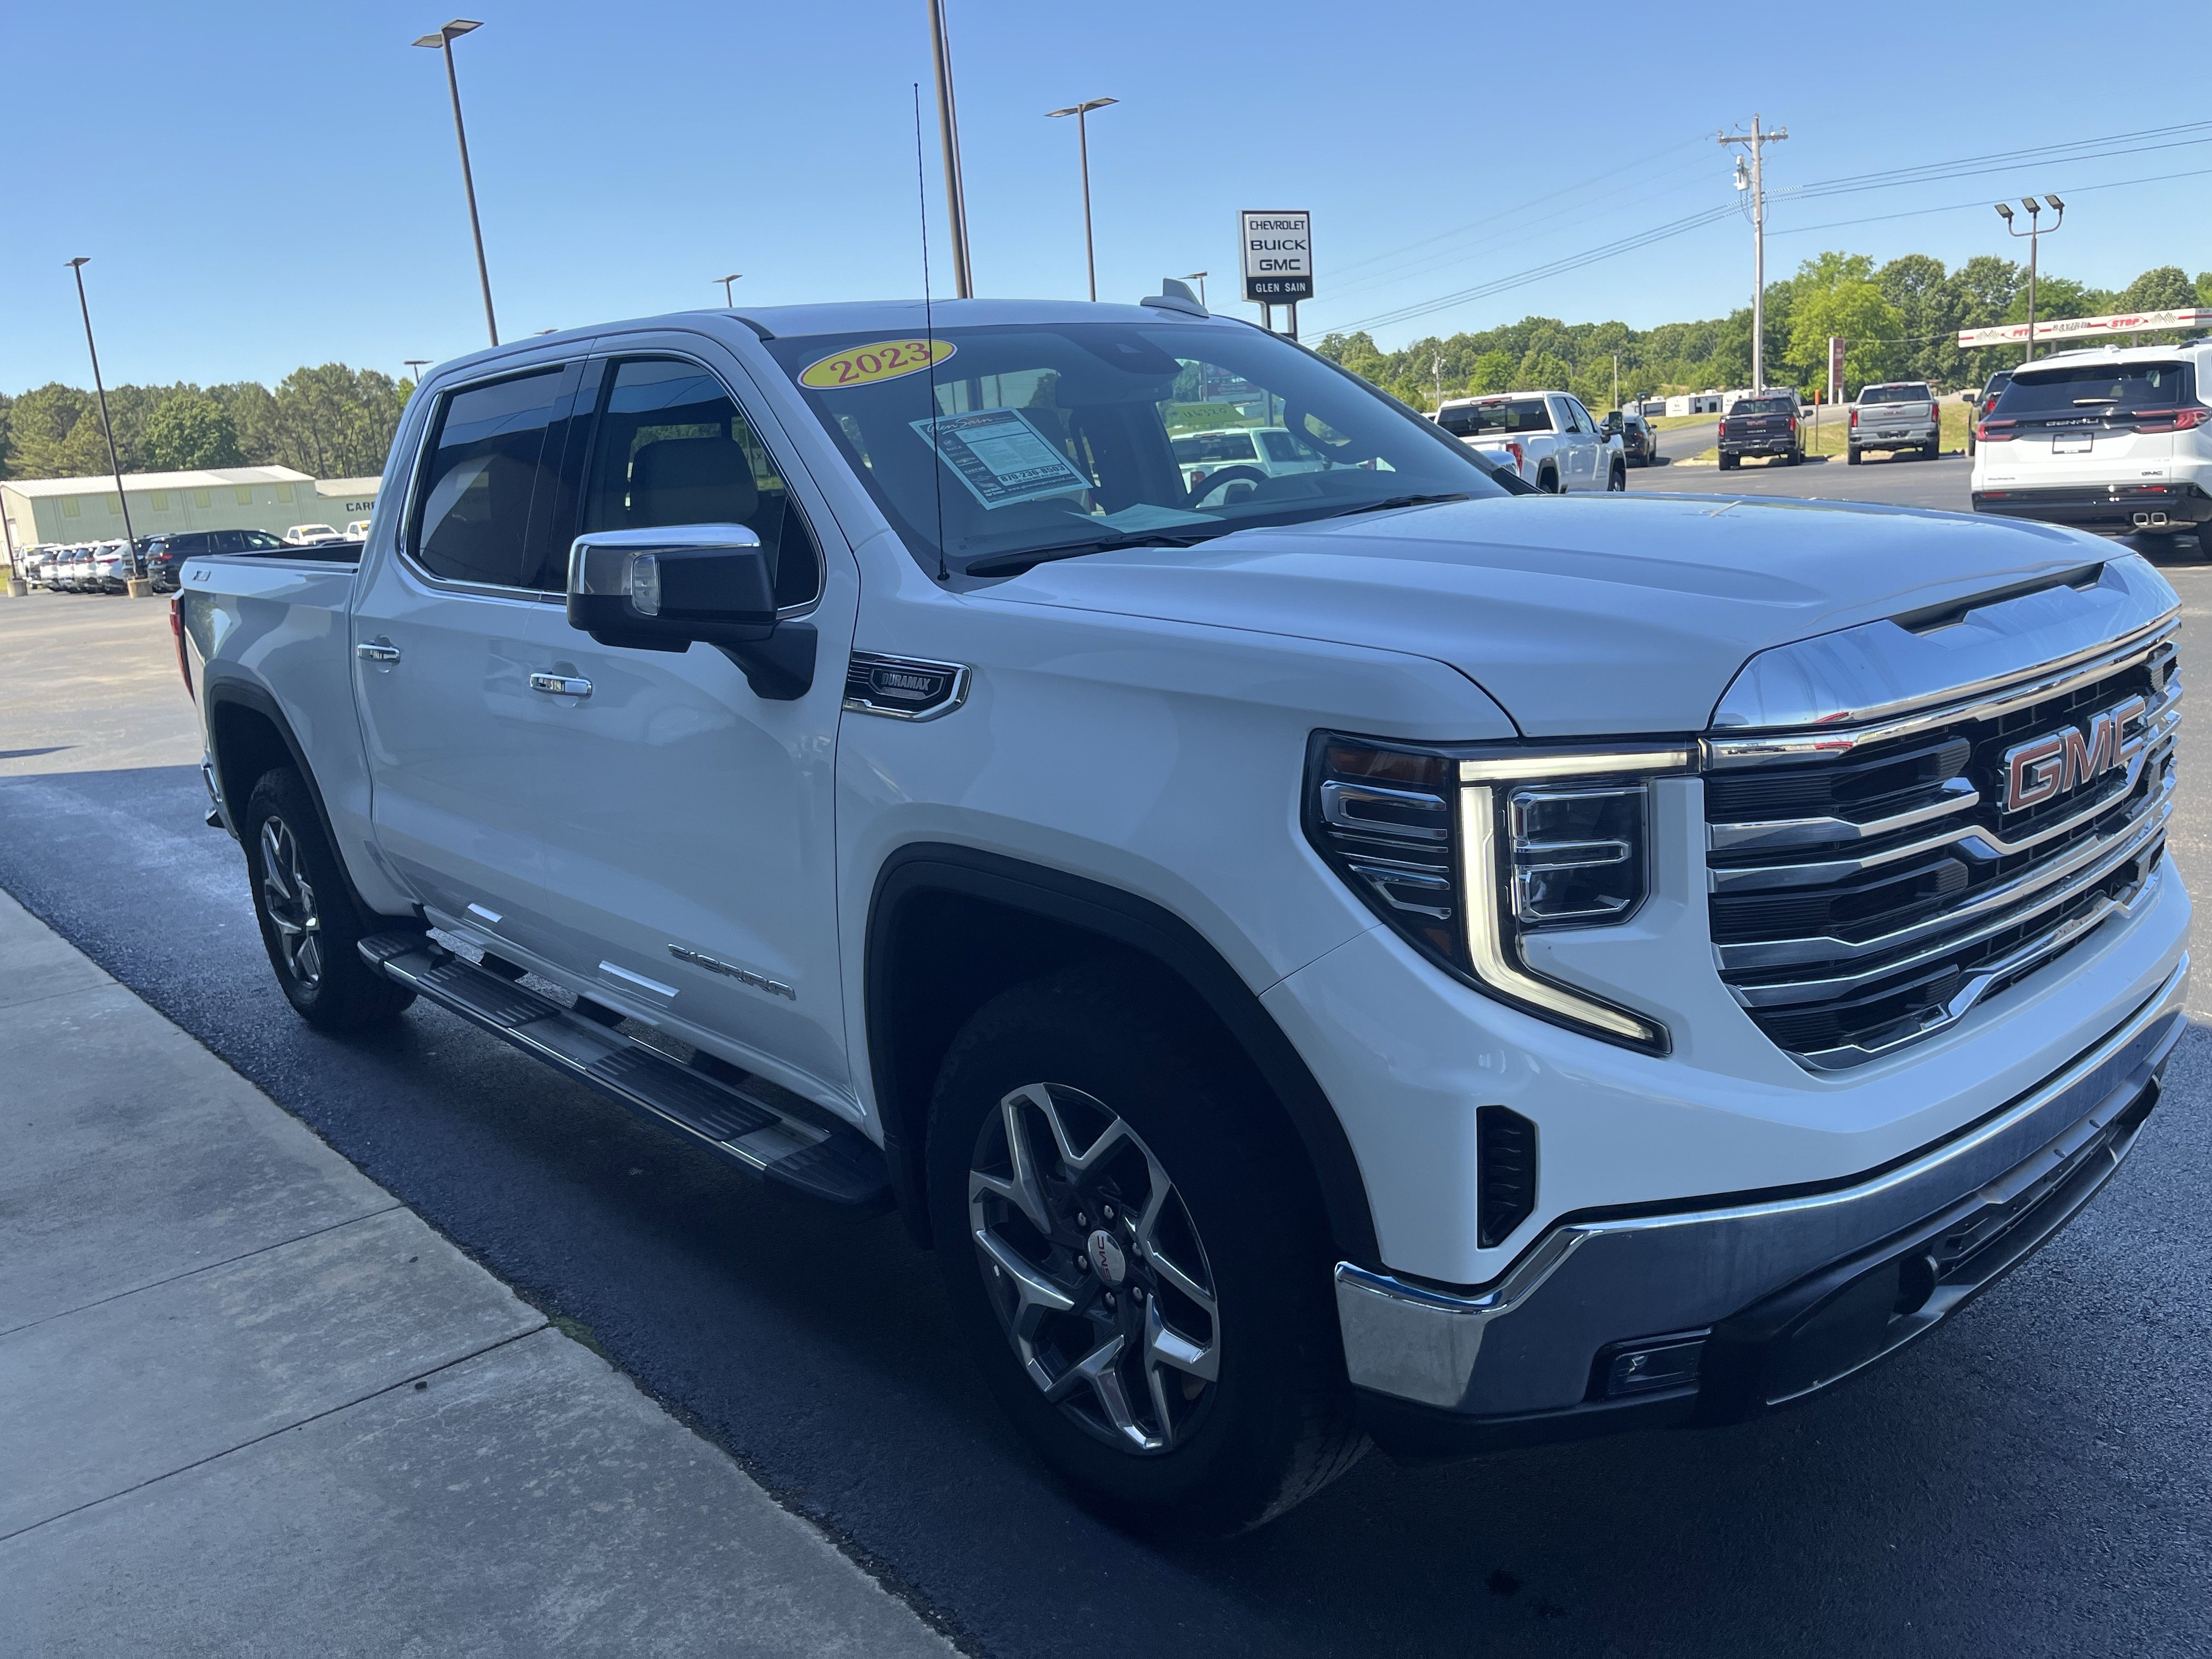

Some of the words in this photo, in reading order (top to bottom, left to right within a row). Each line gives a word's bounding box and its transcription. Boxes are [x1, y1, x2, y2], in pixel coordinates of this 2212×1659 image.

[1250, 221, 1305, 230] CHEVROLET
[1250, 239, 1307, 251] BUICK
[1260, 258, 1301, 270] GMC
[1255, 283, 1280, 293] GLEN
[1285, 283, 1306, 292] SAIN
[2112, 318, 2140, 327] STOP
[830, 342, 930, 383] 2023
[955, 417, 993, 428] Sain
[881, 673, 931, 691] DURAMAX
[2002, 695, 2146, 815] GMC
[1097, 1235, 1113, 1282] GMC
